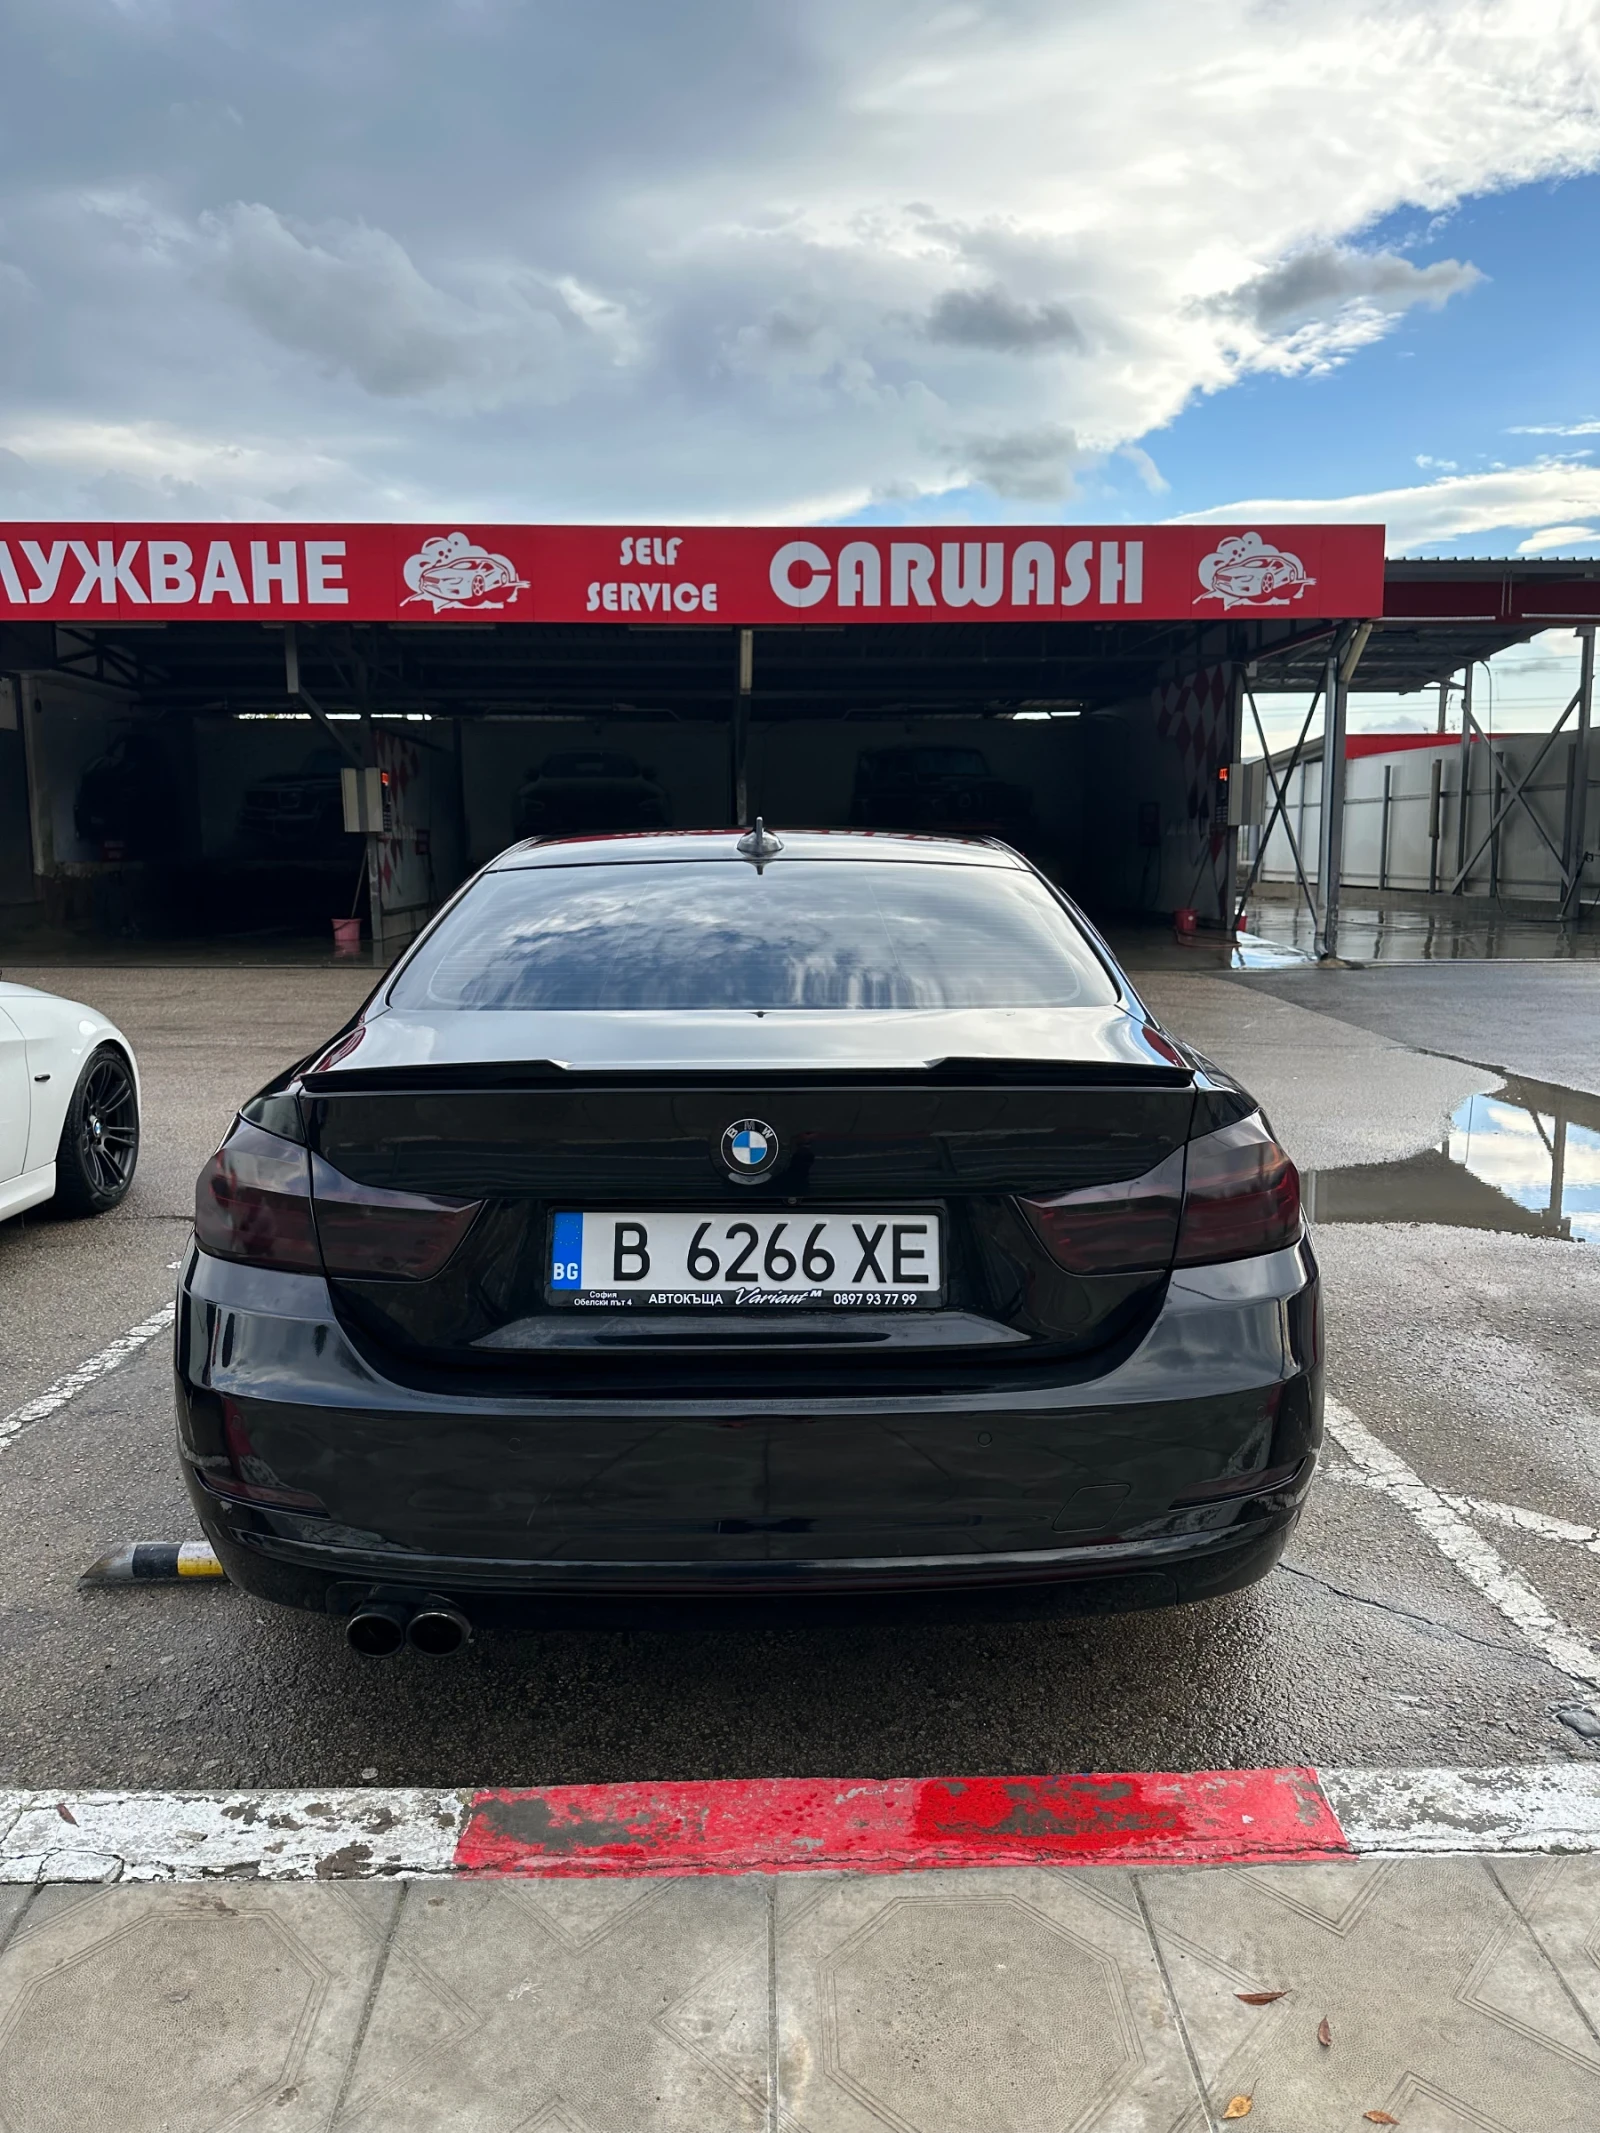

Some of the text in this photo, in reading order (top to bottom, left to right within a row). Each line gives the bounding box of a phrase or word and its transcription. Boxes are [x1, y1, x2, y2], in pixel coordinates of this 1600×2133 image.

[620, 537, 683, 566] SELF
[769, 540, 1143, 608] CARWASH
[586, 582, 718, 612] SERVICE
[726, 1120, 774, 1139] BMW
[613, 1222, 930, 1284] B 6266 XE
[553, 1263, 579, 1281] BG
[589, 1291, 618, 1299] София
[648, 1293, 724, 1306] АВТОКЪЩА
[833, 1293, 917, 1305] 0897 93 77 99
